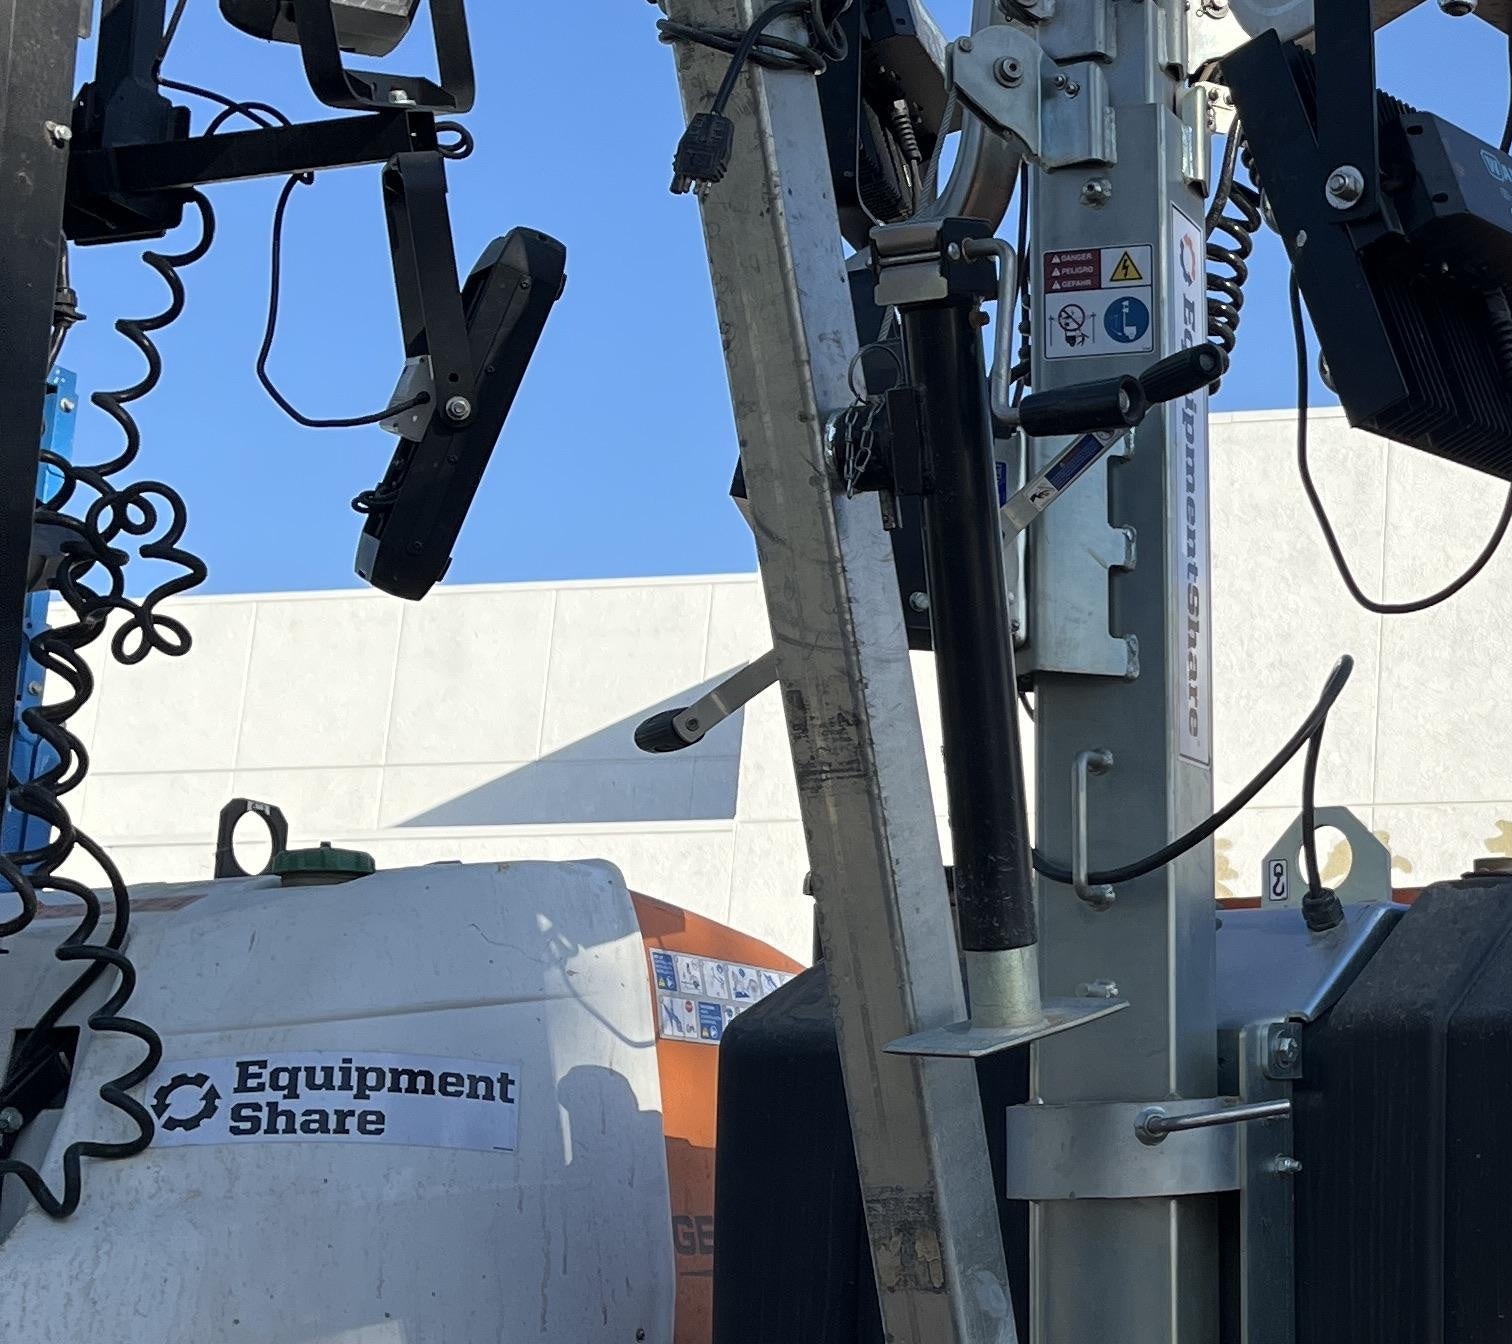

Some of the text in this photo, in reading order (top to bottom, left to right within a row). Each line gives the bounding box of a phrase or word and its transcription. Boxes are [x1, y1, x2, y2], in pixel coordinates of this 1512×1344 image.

[1061, 253, 1092, 262] DANGER
[1061, 266, 1094, 275] PELIGRO
[1061, 279, 1092, 288] GEFAHR
[1181, 293, 1200, 737] EqipmentShare
[233, 1058, 515, 1104] Equipment
[229, 1101, 386, 1136] Share
